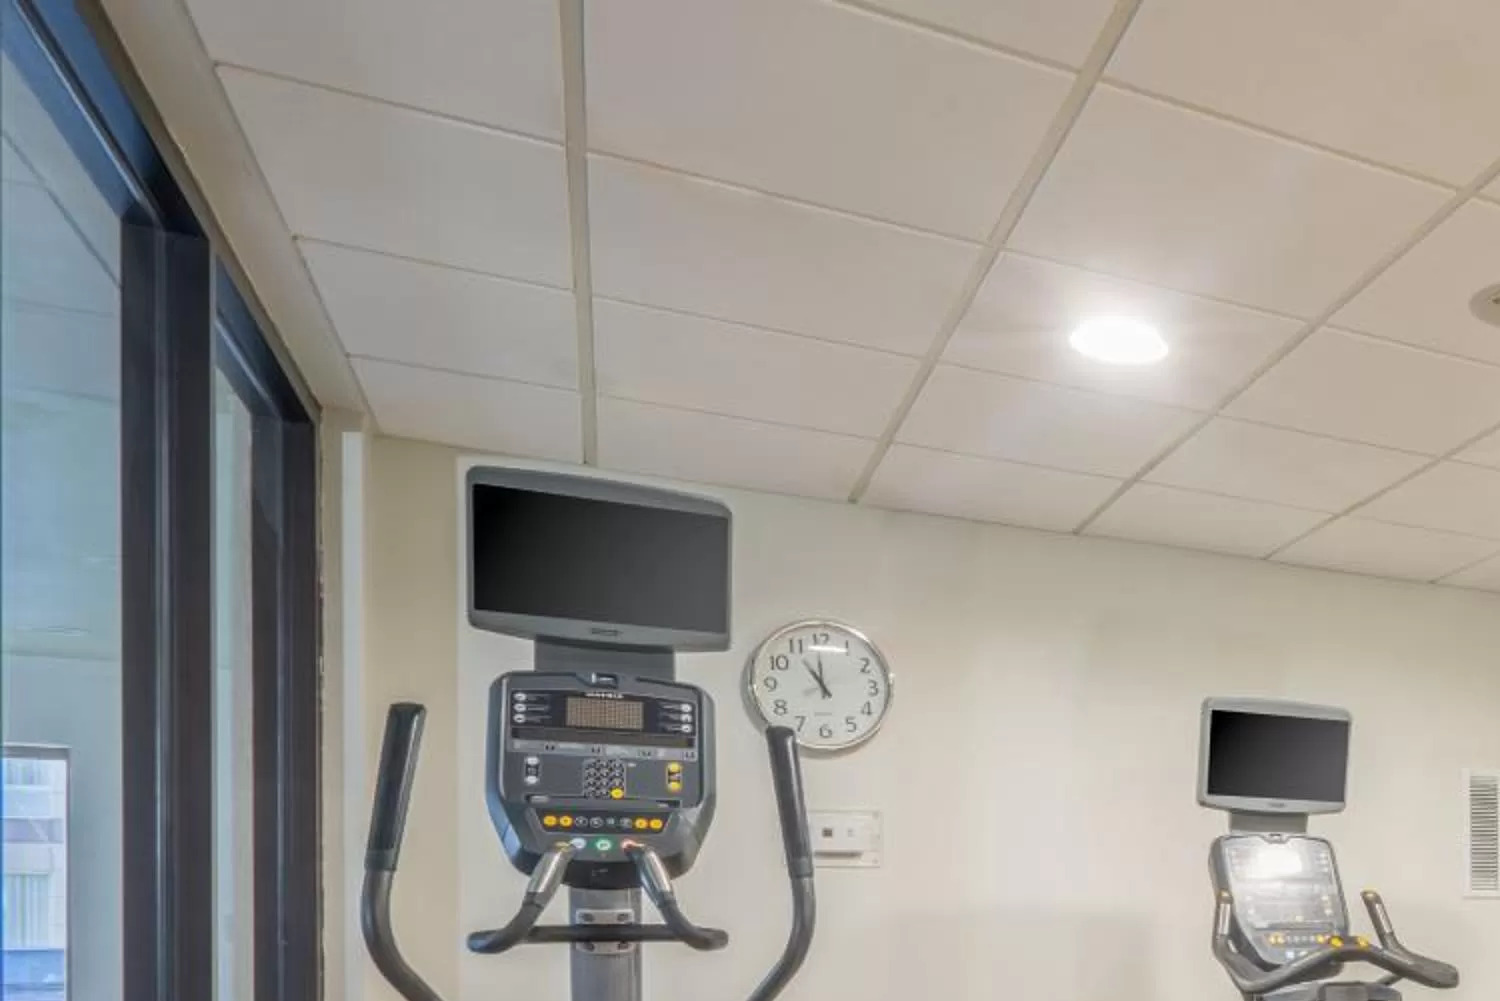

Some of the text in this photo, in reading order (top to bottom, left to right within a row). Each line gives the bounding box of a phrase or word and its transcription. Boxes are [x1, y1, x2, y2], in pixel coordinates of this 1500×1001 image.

[789, 639, 803, 654] 11
[812, 632, 830, 647] 12
[769, 654, 789, 671] 10
[859, 657, 871, 674] 2
[763, 676, 778, 692] 9
[867, 679, 879, 697] 3
[773, 699, 788, 716] 8
[861, 700, 872, 716] 4
[794, 715, 807, 733] 7
[819, 724, 833, 739] 6
[844, 716, 857, 733] 5
